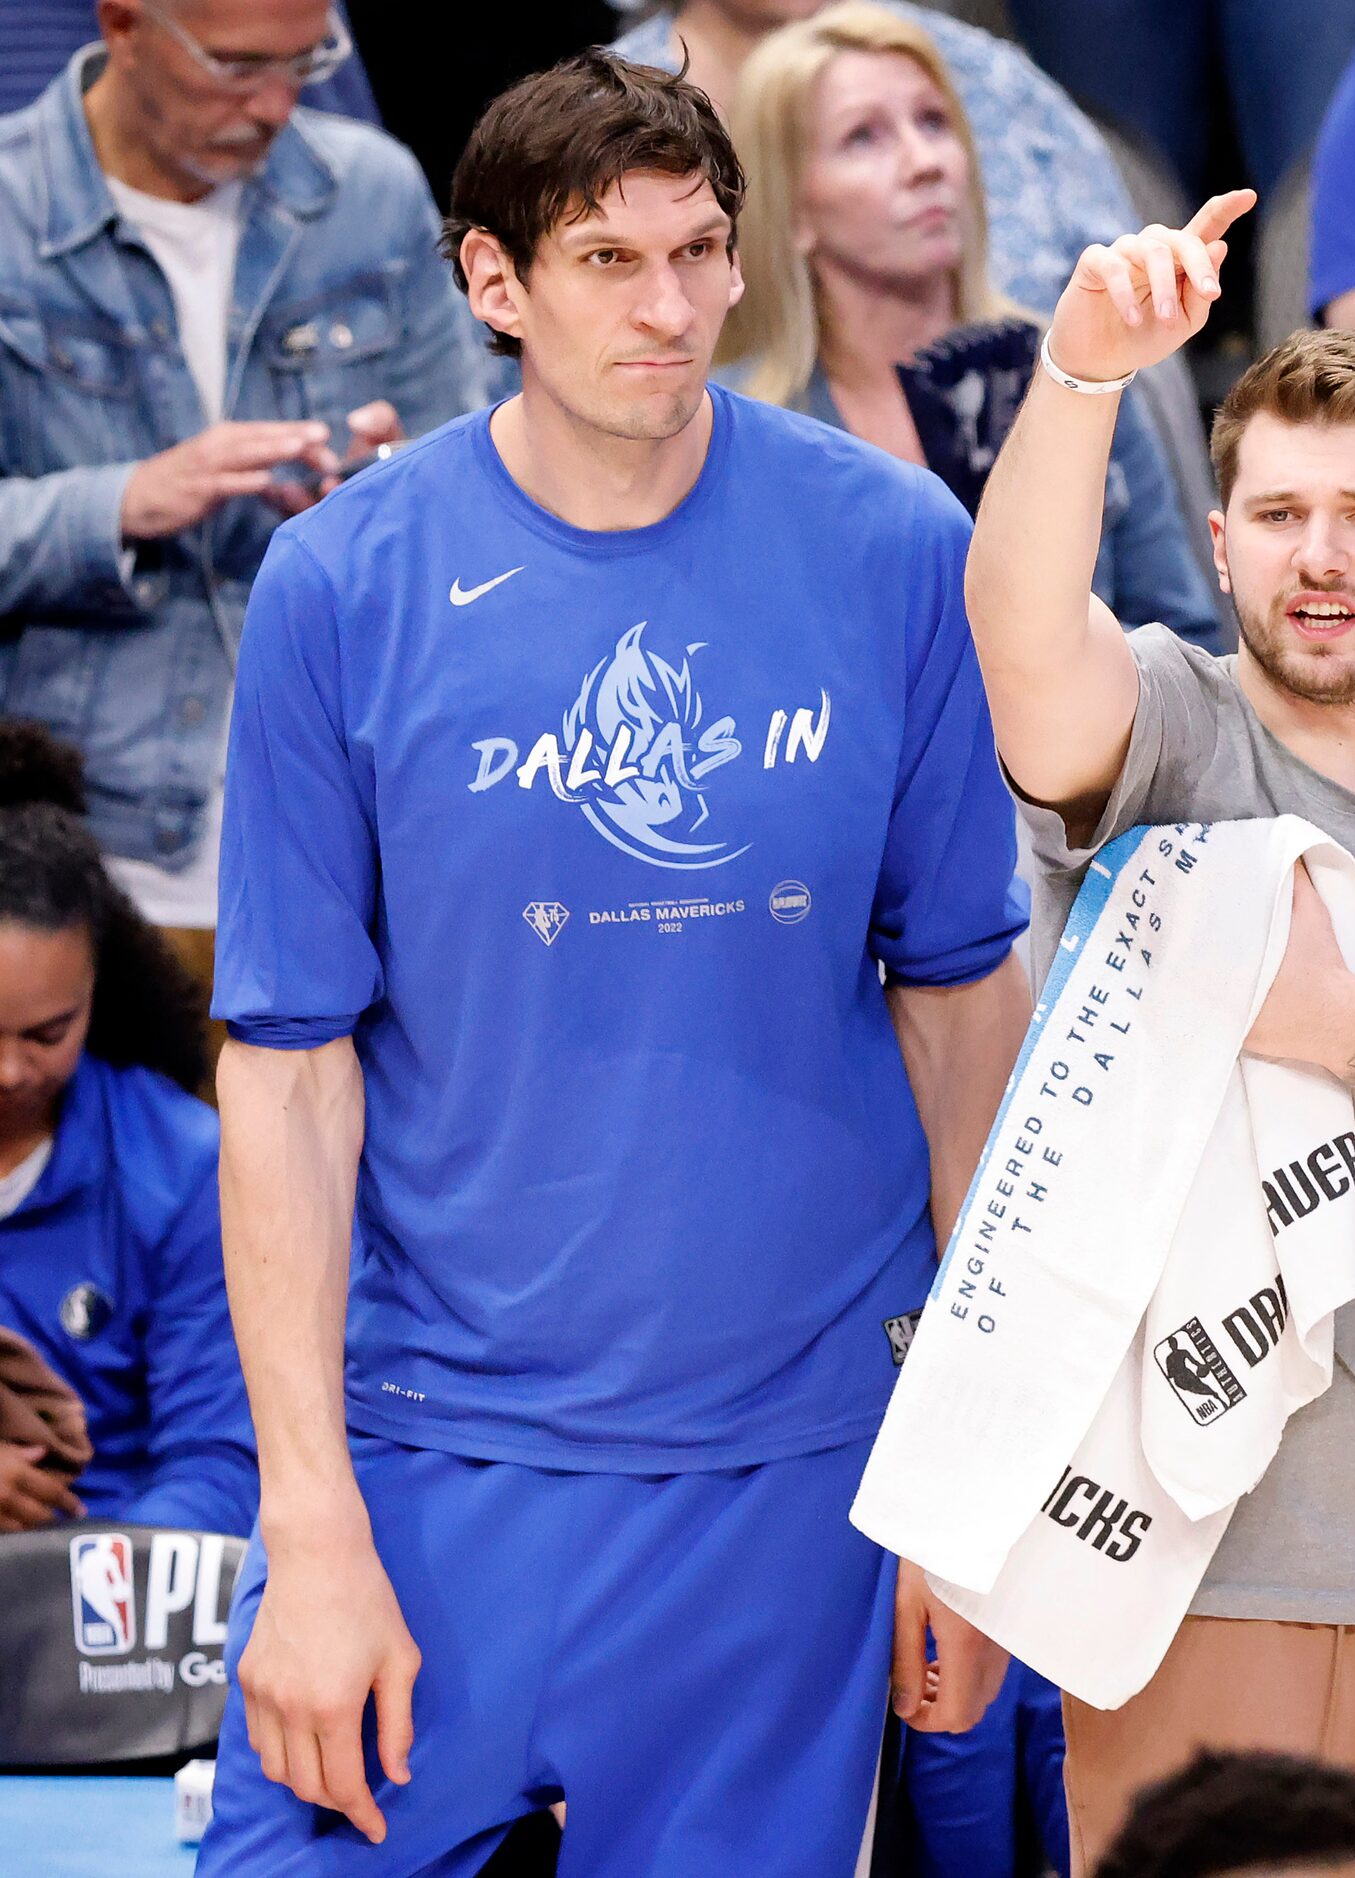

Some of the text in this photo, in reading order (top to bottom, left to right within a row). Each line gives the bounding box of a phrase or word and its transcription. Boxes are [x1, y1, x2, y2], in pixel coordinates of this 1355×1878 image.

[467, 687, 831, 802] DALLAS IN
[588, 909, 651, 924] DALLAS
[655, 900, 745, 920] MAVERICKS
[658, 922, 683, 934] 2022
[951, 1116, 1043, 1320] ENGINEERED
[1040, 1062, 1070, 1097] TO
[1067, 986, 1110, 1042] THE
[1106, 869, 1156, 972] EXACT
[977, 1277, 1007, 1333] OF
[1011, 1146, 1063, 1233] THE
[1071, 912, 1163, 1106] DALLAS
[381, 1381, 426, 1403] DRI-FIT
[1195, 1398, 1219, 1421] NBA
